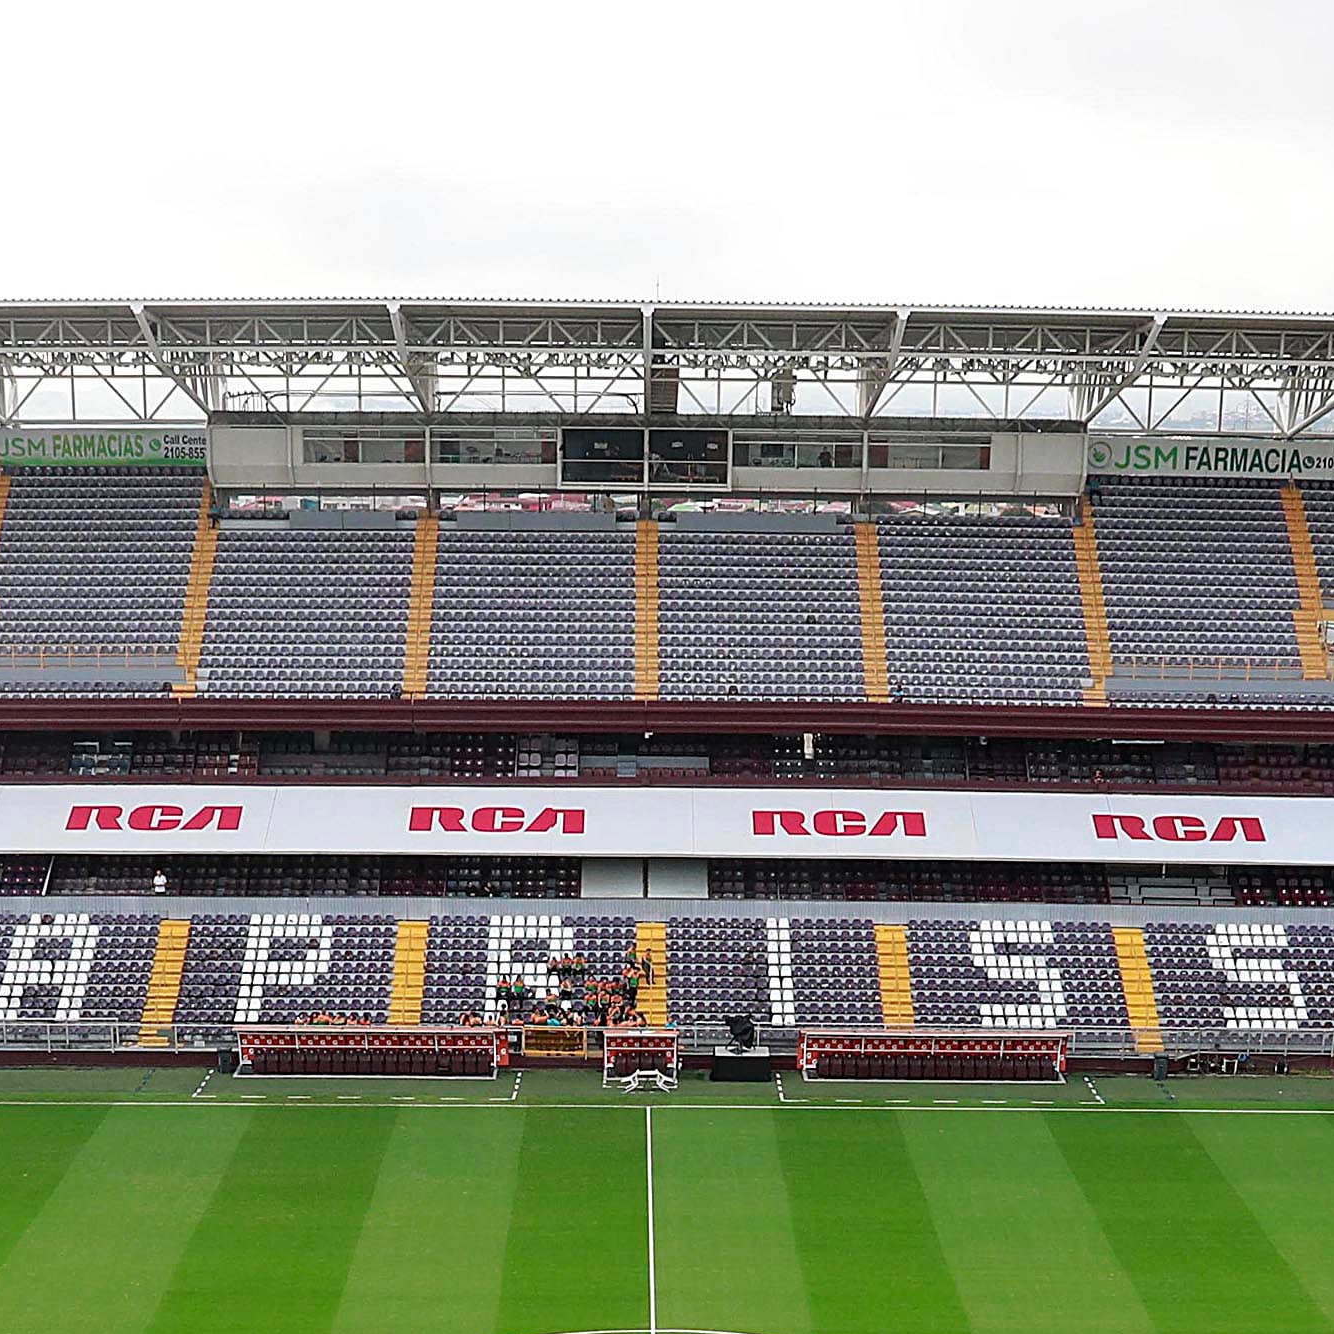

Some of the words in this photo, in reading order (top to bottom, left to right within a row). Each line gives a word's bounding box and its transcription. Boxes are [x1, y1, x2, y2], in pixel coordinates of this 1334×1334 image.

[52, 434, 144, 458] FARMACIAS
[163, 434, 180, 445] Call
[182, 435, 206, 445] Cente
[164, 447, 206, 459] 2105-855
[1114, 445, 1177, 470] JSM
[1185, 446, 1302, 473] FARMACIA
[67, 804, 243, 832] RCA
[409, 806, 585, 835] RCA
[753, 809, 927, 838] RCA
[1093, 813, 1266, 842] RCA
